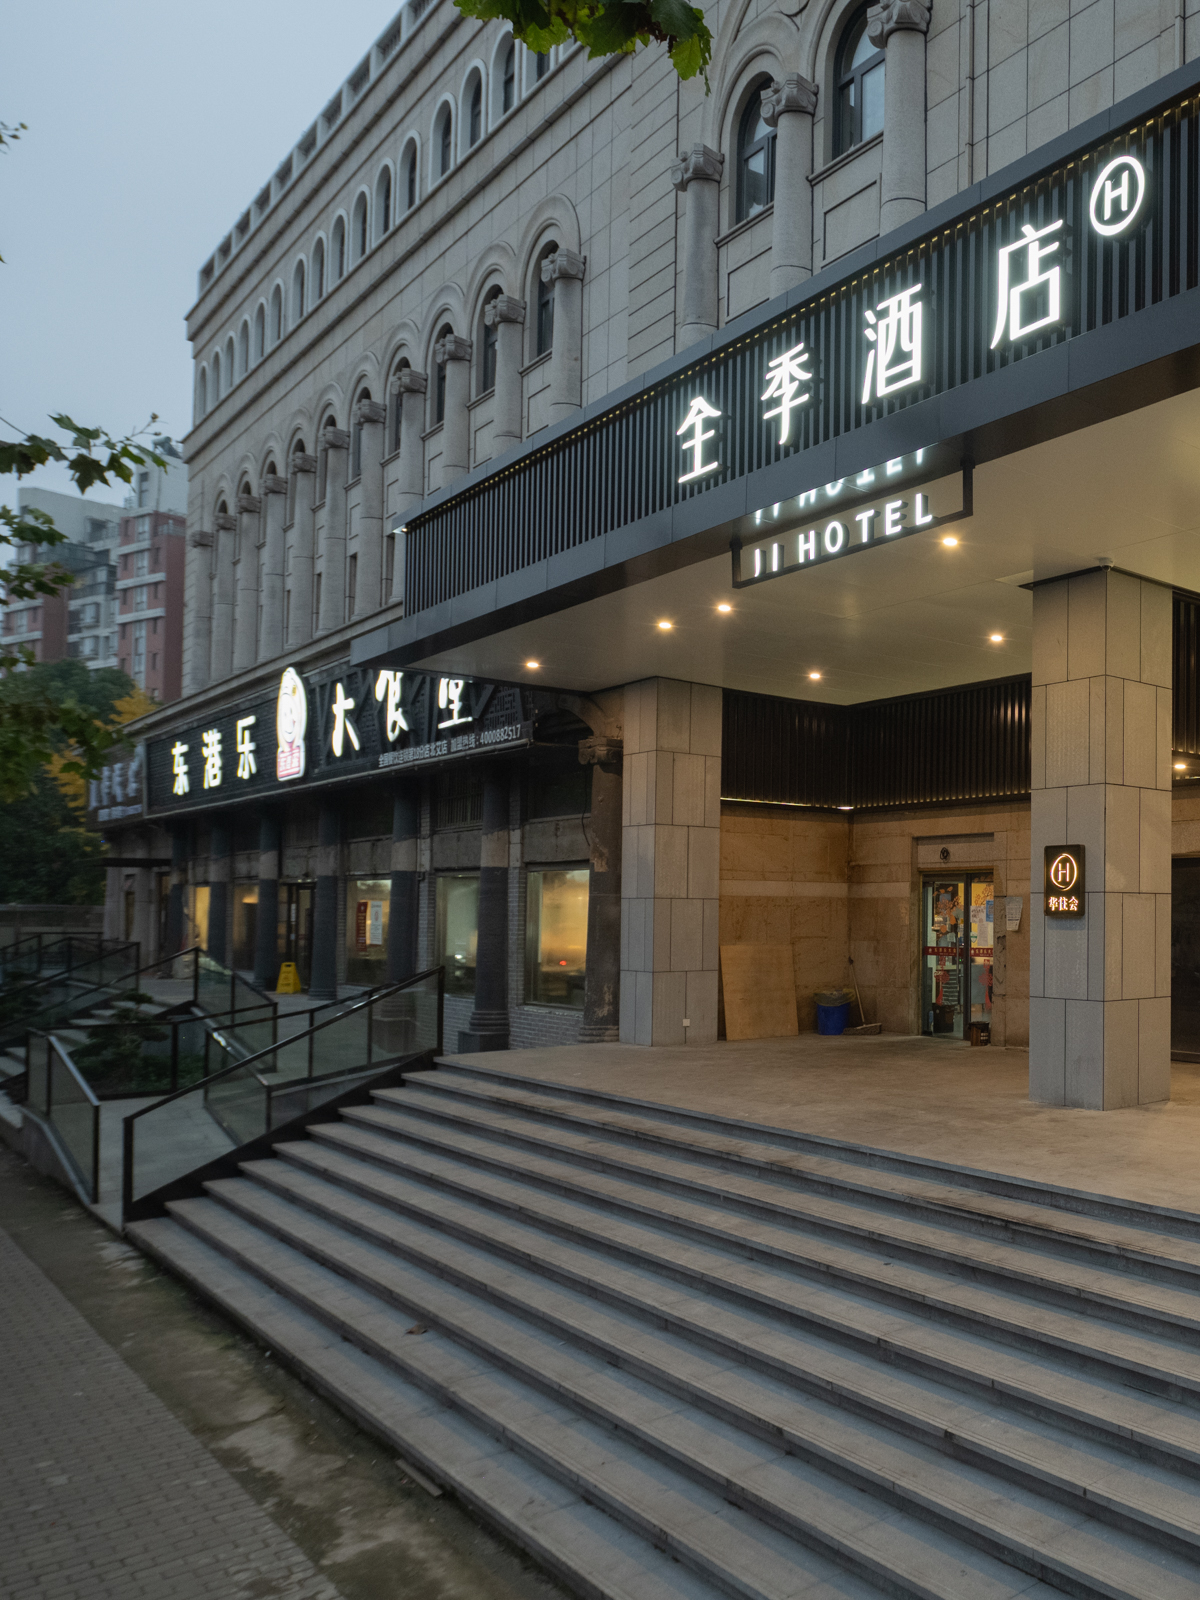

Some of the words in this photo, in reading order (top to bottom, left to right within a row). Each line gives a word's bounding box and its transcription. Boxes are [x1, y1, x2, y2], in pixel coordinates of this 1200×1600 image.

[677, 219, 1063, 484] 全季酒店
[754, 542, 778, 578] JI
[798, 493, 933, 563] HOTEL
[171, 714, 257, 796] 东港乐
[1048, 896, 1079, 911] 华住会
